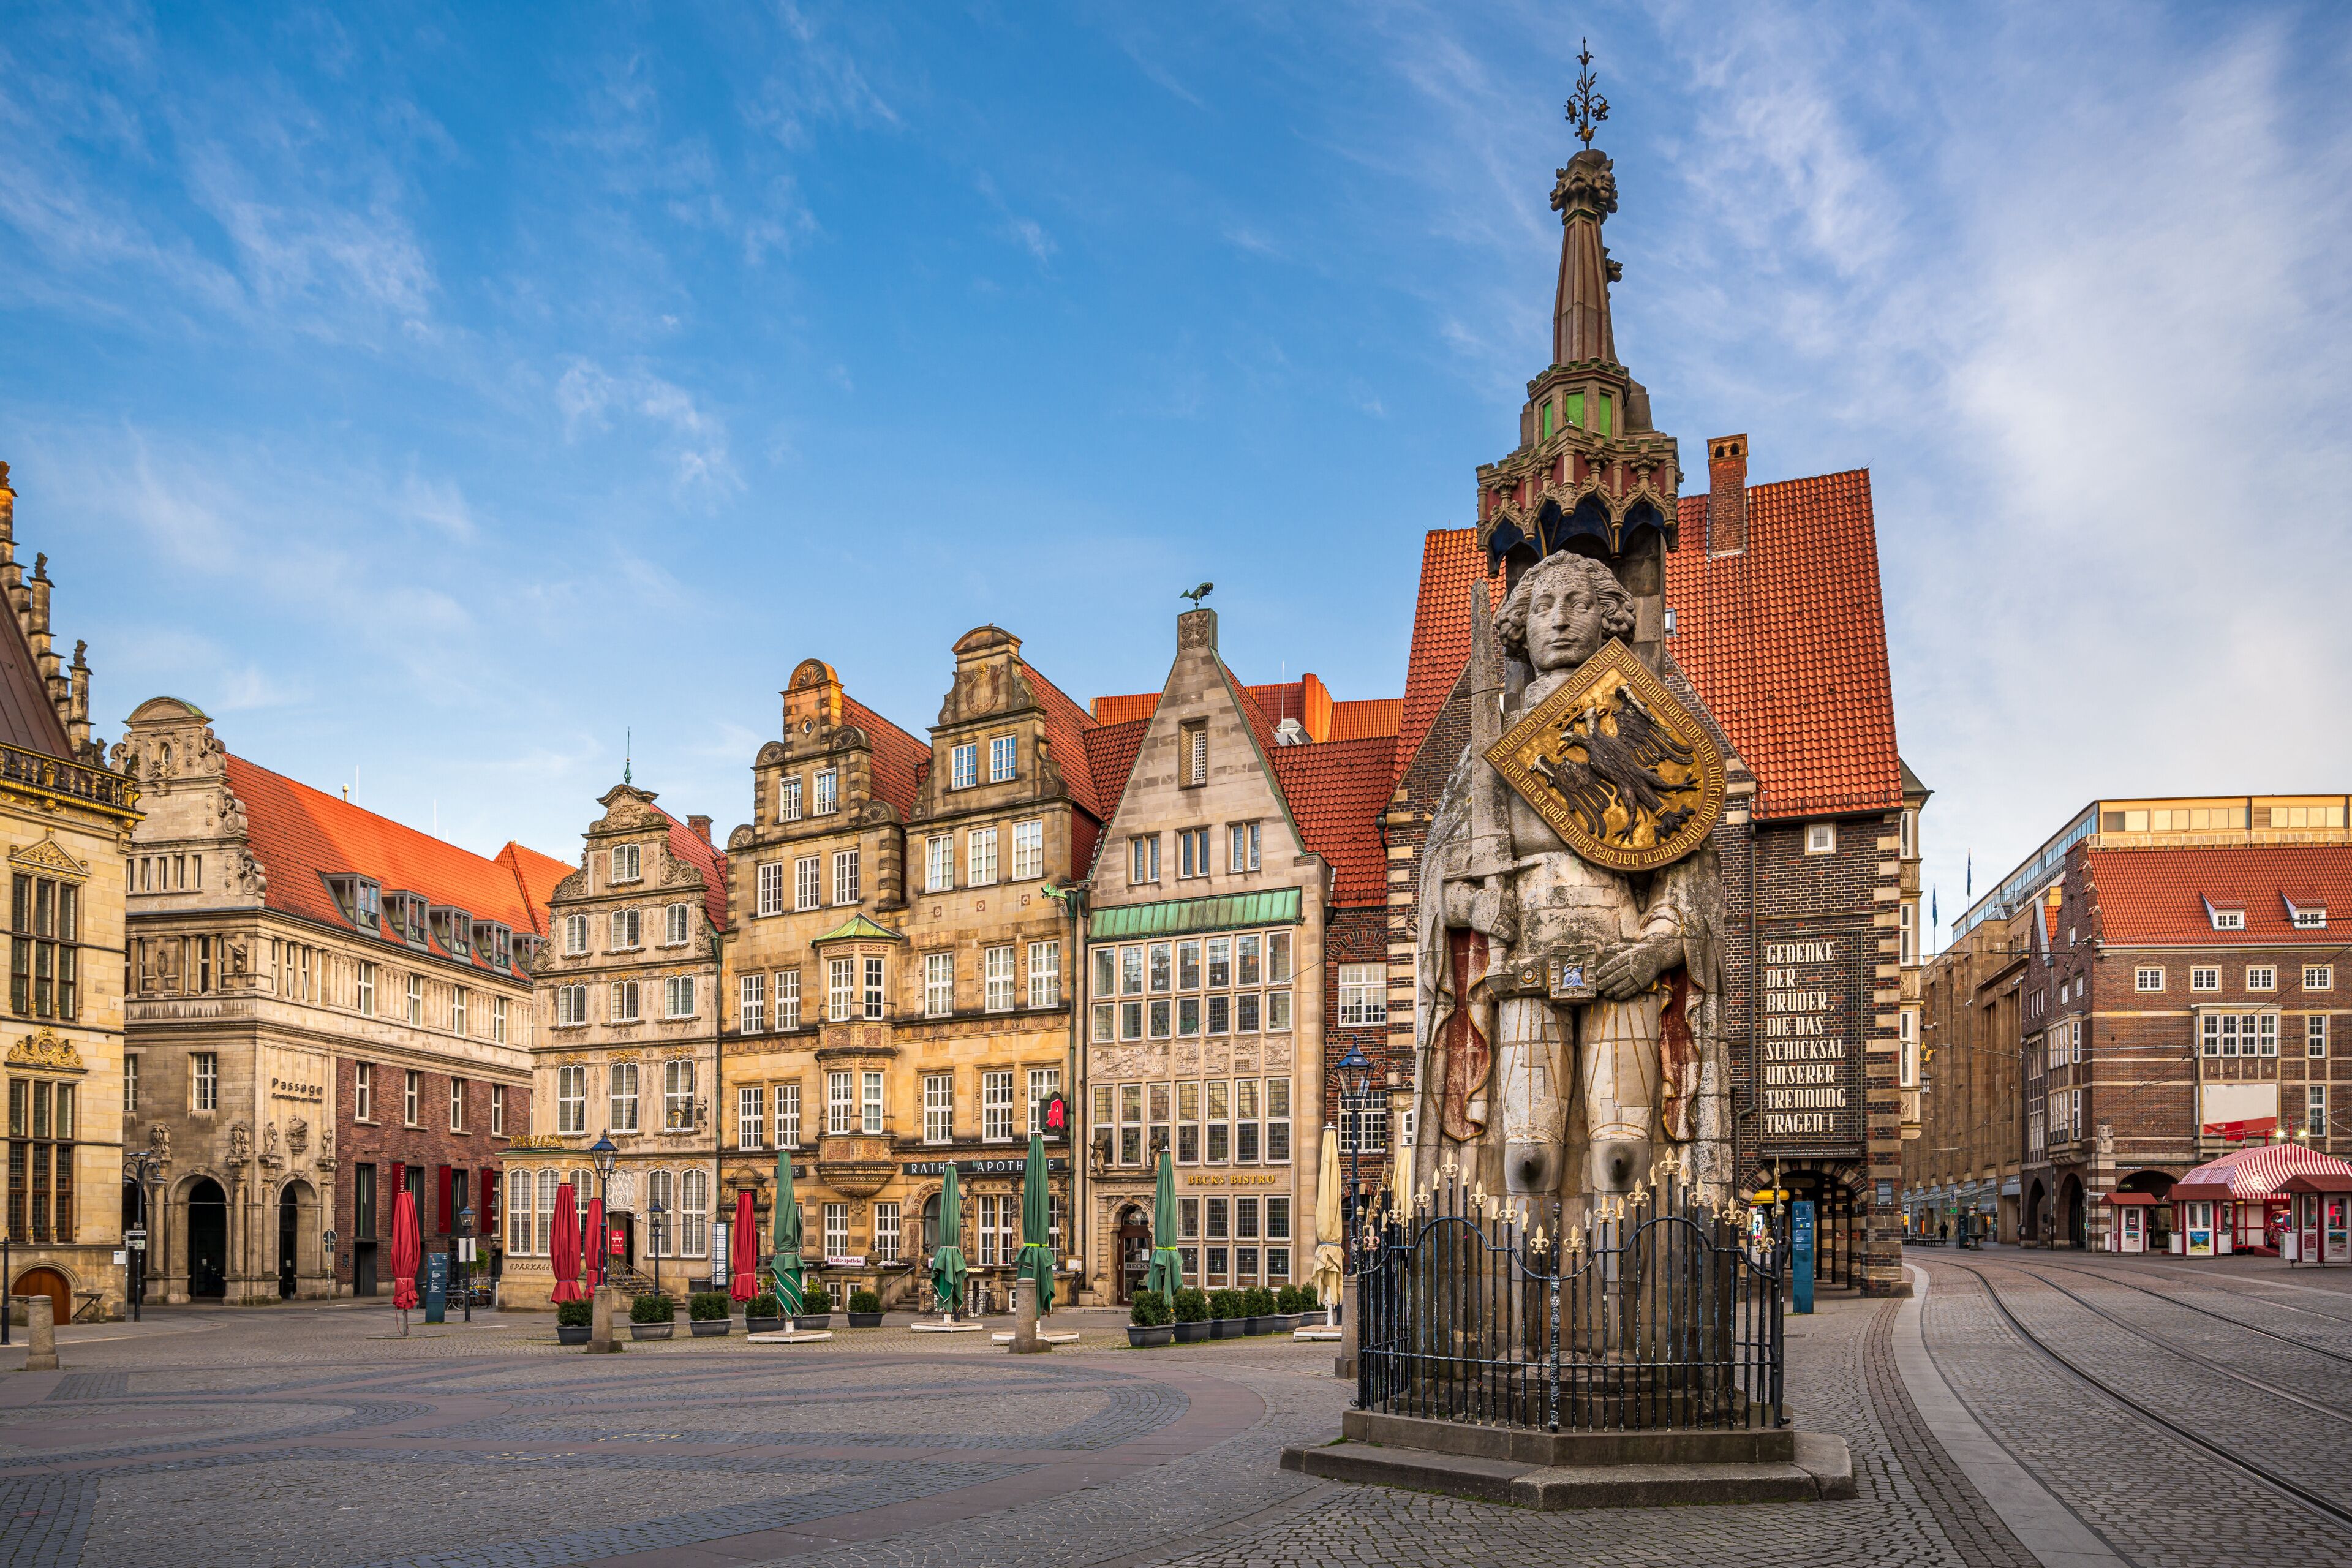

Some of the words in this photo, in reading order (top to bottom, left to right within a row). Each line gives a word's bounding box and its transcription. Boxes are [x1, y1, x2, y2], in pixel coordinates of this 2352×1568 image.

[1766, 942, 1834, 964] GEDENKE
[1766, 968, 1796, 988] DER
[1766, 989, 1835, 1012] BRÜDER,
[1766, 1017, 1790, 1036] DIE
[1796, 1016, 1823, 1035] DAS
[1766, 1039, 1845, 1061] SCHICKSAL
[1766, 1064, 1835, 1085] UNSERER
[272, 1077, 323, 1096] Passage
[1766, 1088, 1846, 1109] TRENNUNG
[911, 1163, 945, 1174] RATH
[977, 1159, 1054, 1172] APOTHE
[1230, 1175, 1275, 1185] BISTRO
